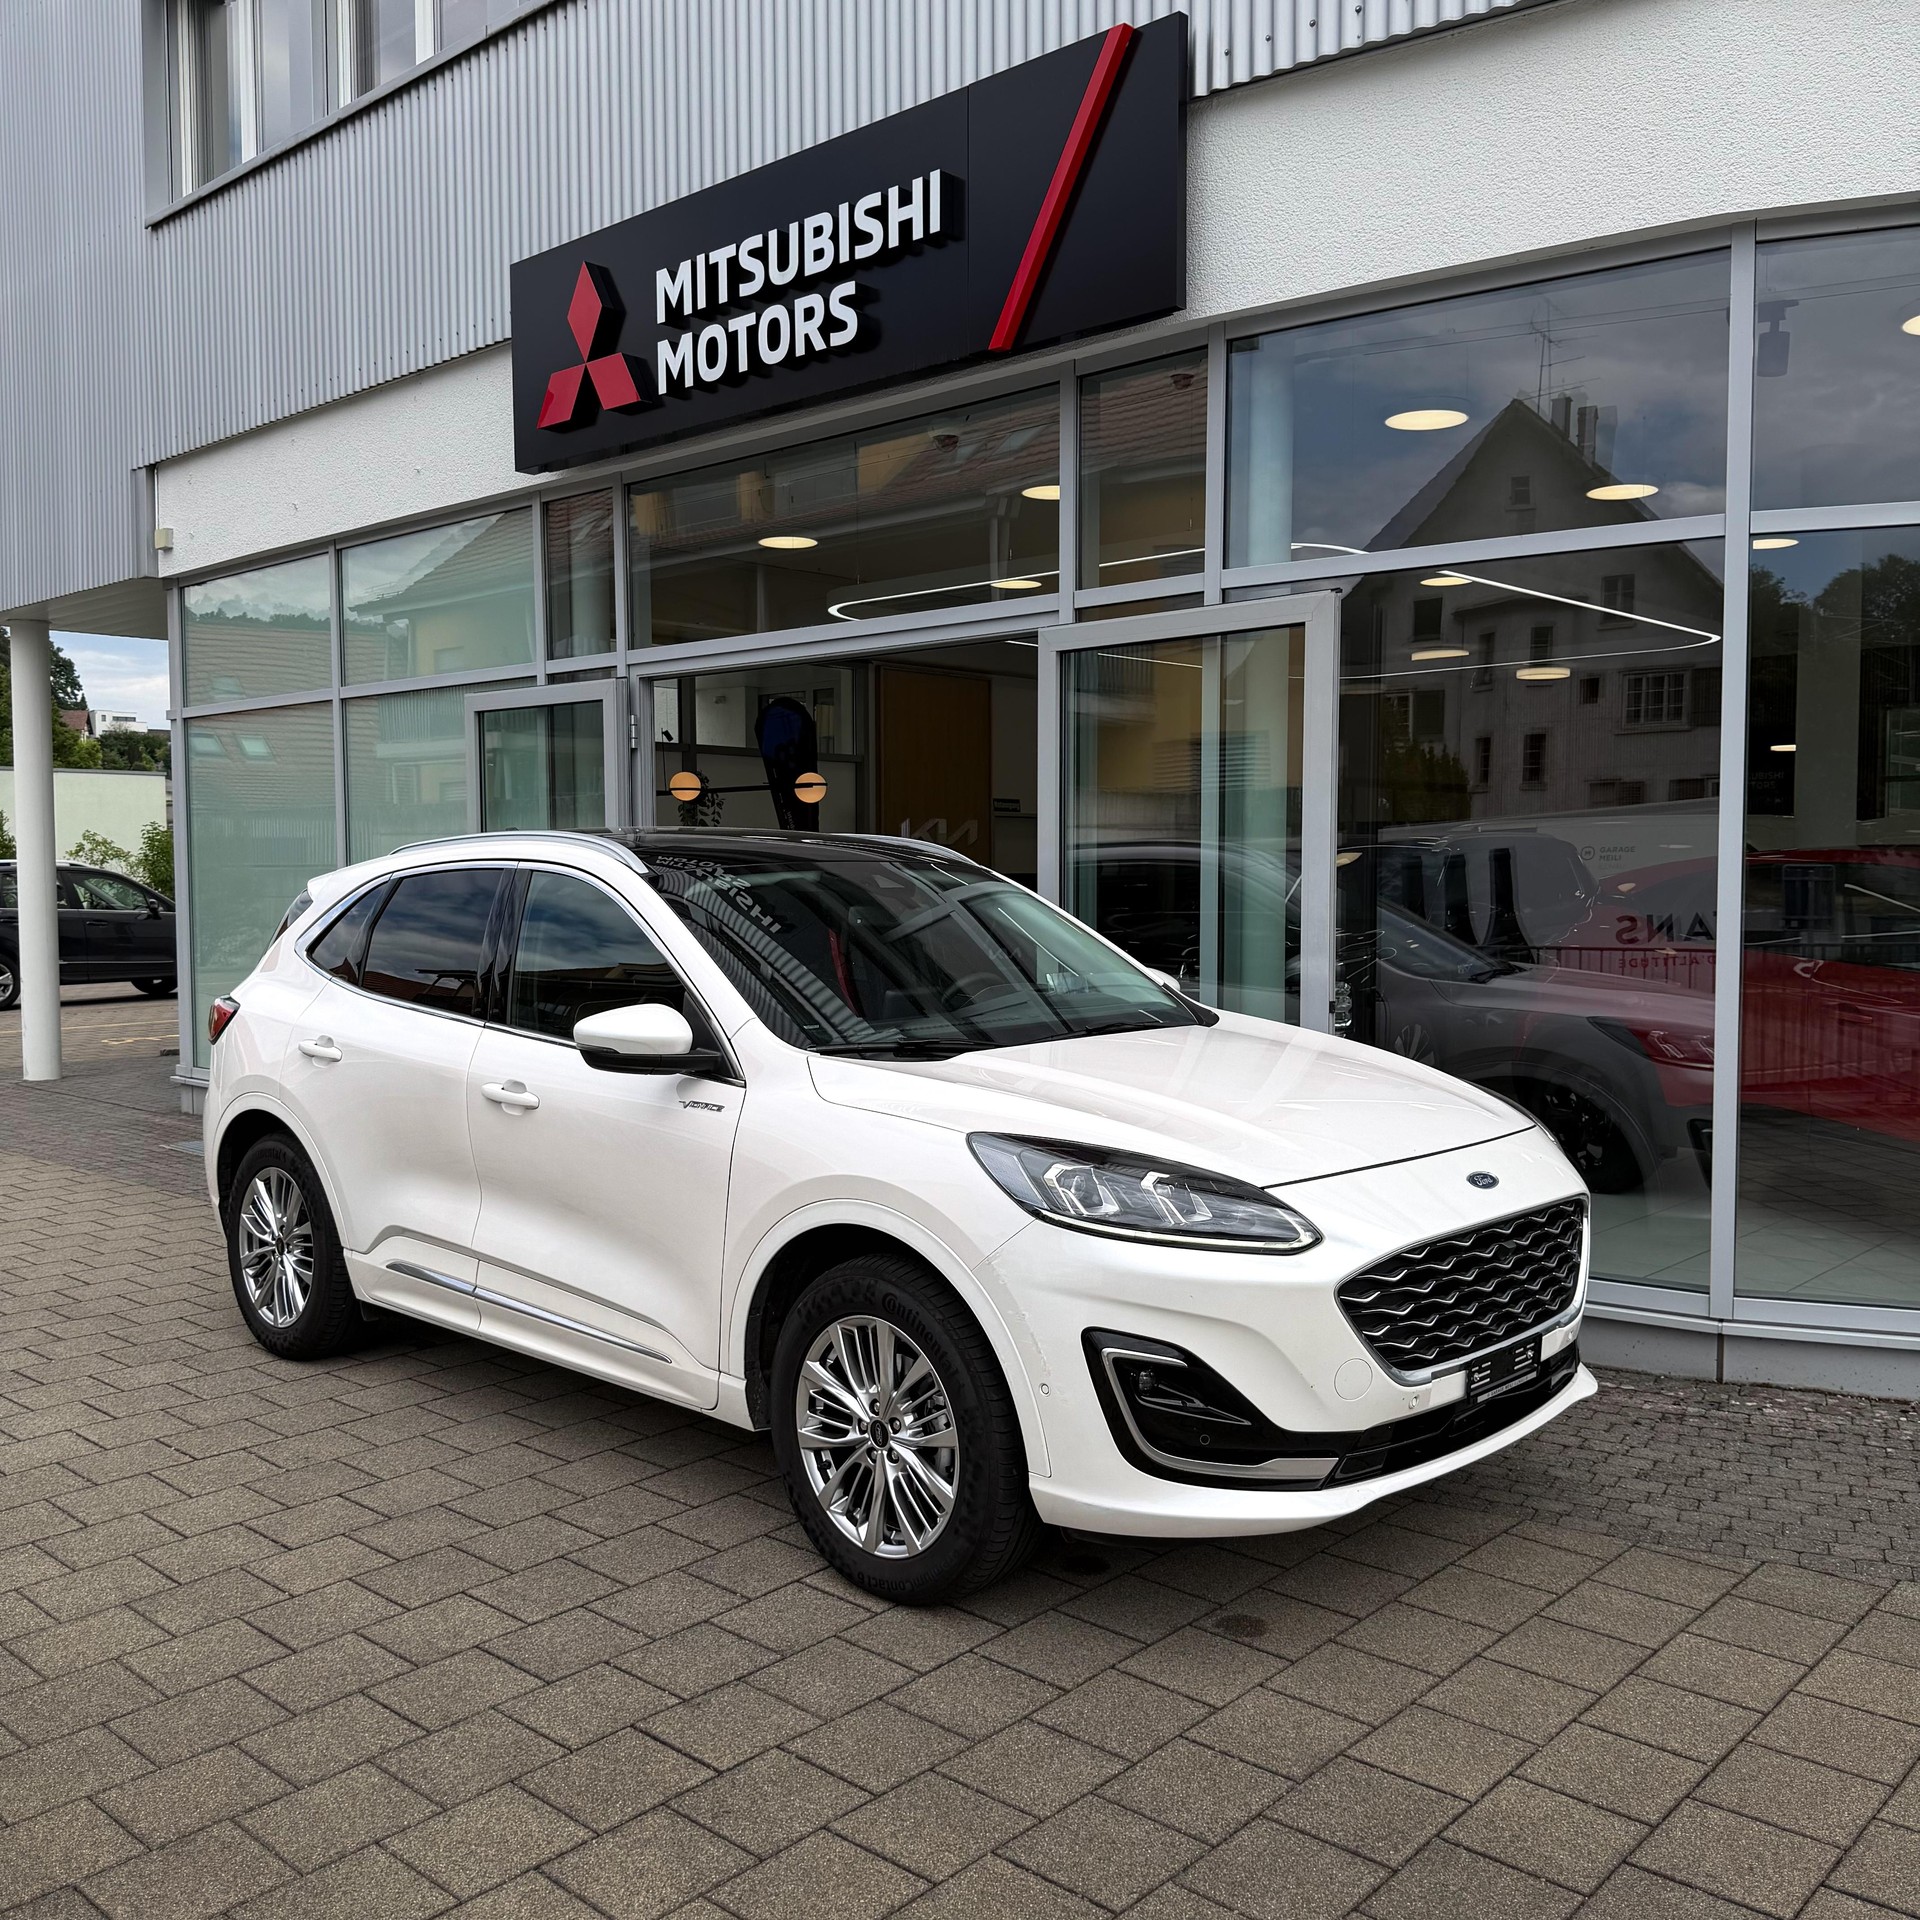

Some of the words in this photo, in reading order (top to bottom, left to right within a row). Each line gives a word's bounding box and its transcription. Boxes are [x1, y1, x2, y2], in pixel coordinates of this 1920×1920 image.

[655, 168, 941, 325] MITSUBISHI
[657, 280, 858, 396] MOTORS
[1599, 846, 1636, 854] GARAGE
[1599, 854, 1622, 862] MEILI
[881, 1292, 959, 1376] Continental
